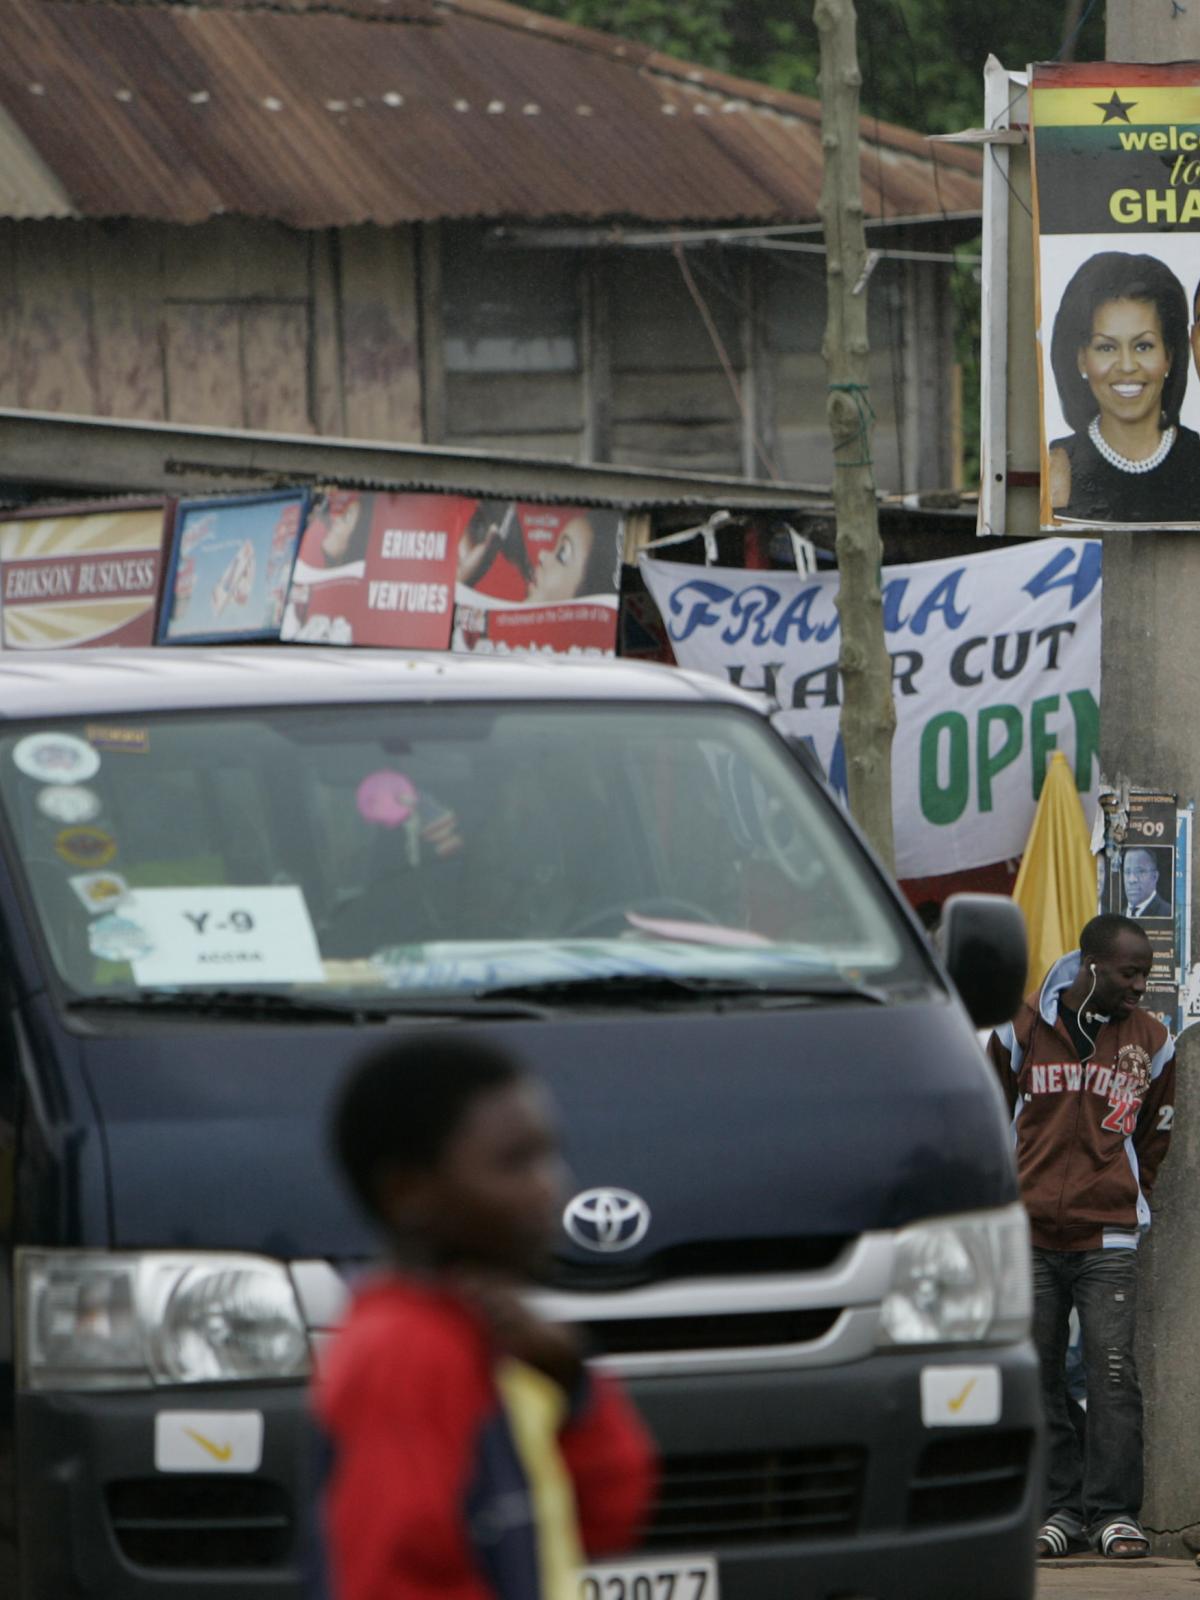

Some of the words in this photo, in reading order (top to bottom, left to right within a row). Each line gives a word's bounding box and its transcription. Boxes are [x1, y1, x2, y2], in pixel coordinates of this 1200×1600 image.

[381, 528, 447, 561] ERIKSON
[6, 565, 74, 599] ERIKSON
[78, 558, 156, 594] BUSINESS
[1022, 541, 1102, 610] 4
[367, 580, 448, 614] VENTURES
[726, 649, 923, 709] HAR
[949, 621, 1077, 687] CUT
[182, 909, 254, 934] Y-9
[1032, 1062, 1083, 1094] NEW
[1156, 1104, 1174, 1131] 2
